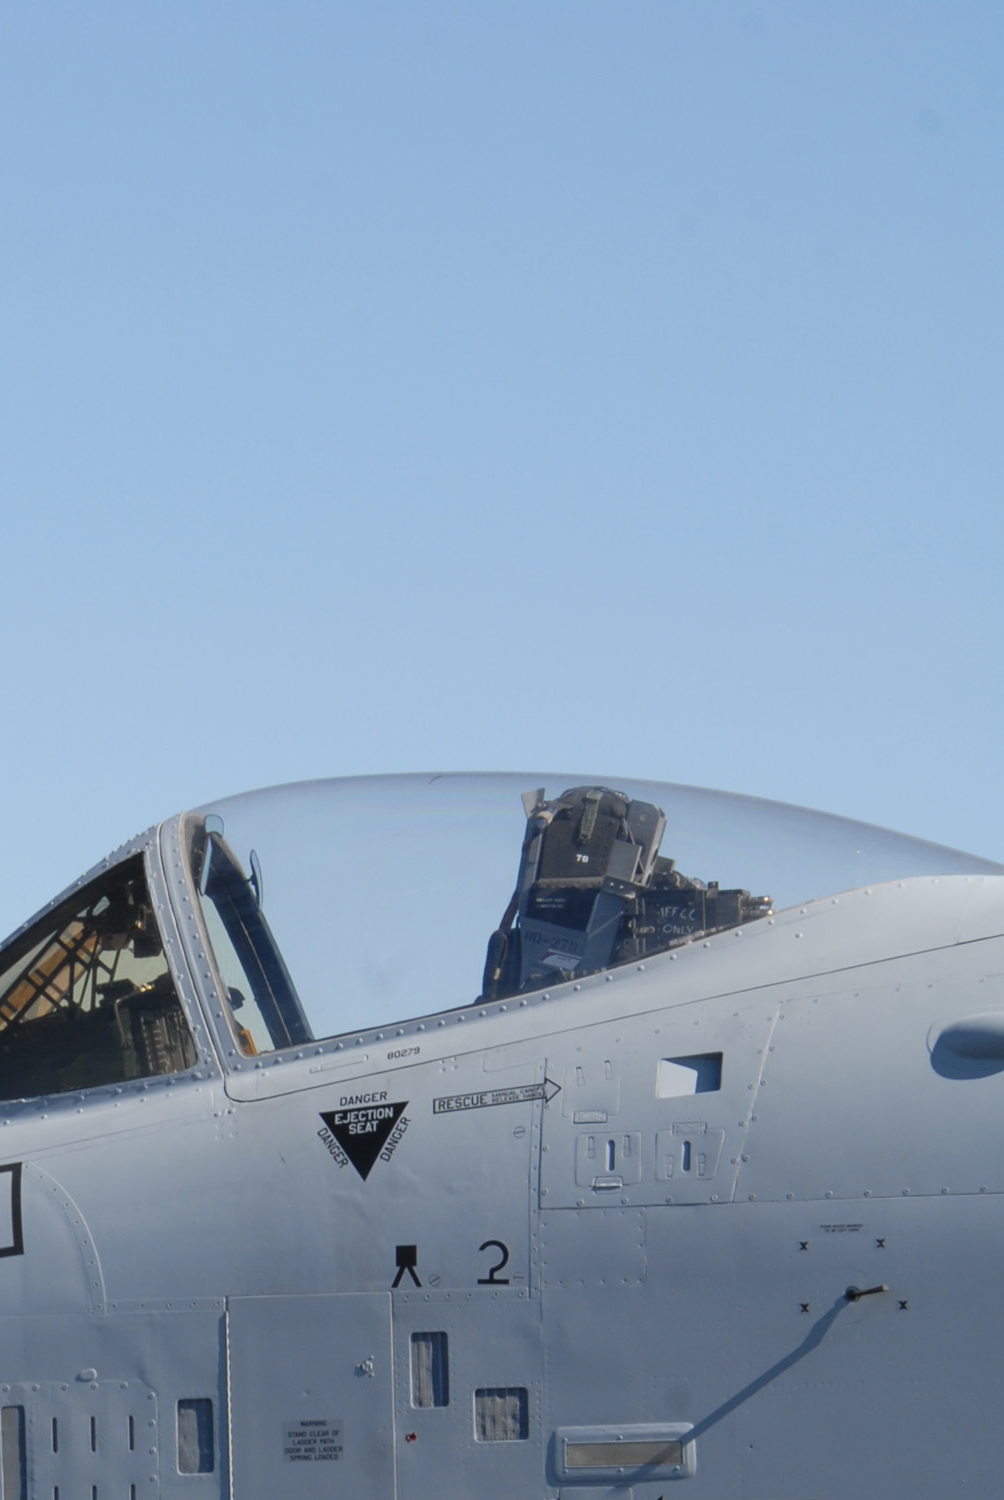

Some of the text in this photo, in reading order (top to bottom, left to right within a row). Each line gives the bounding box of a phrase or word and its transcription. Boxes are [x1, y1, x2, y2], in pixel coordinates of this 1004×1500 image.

[662, 923, 694, 934] ONLY
[387, 1046, 420, 1060] 80279
[339, 1091, 388, 1106] DANGER
[438, 1094, 488, 1111] RESCUE
[334, 1107, 394, 1124] EJECTION
[348, 1120, 379, 1134] SEAT
[380, 1116, 411, 1162] DANGER
[316, 1127, 349, 1168] DANGER
[304, 1446, 316, 1454] AND
